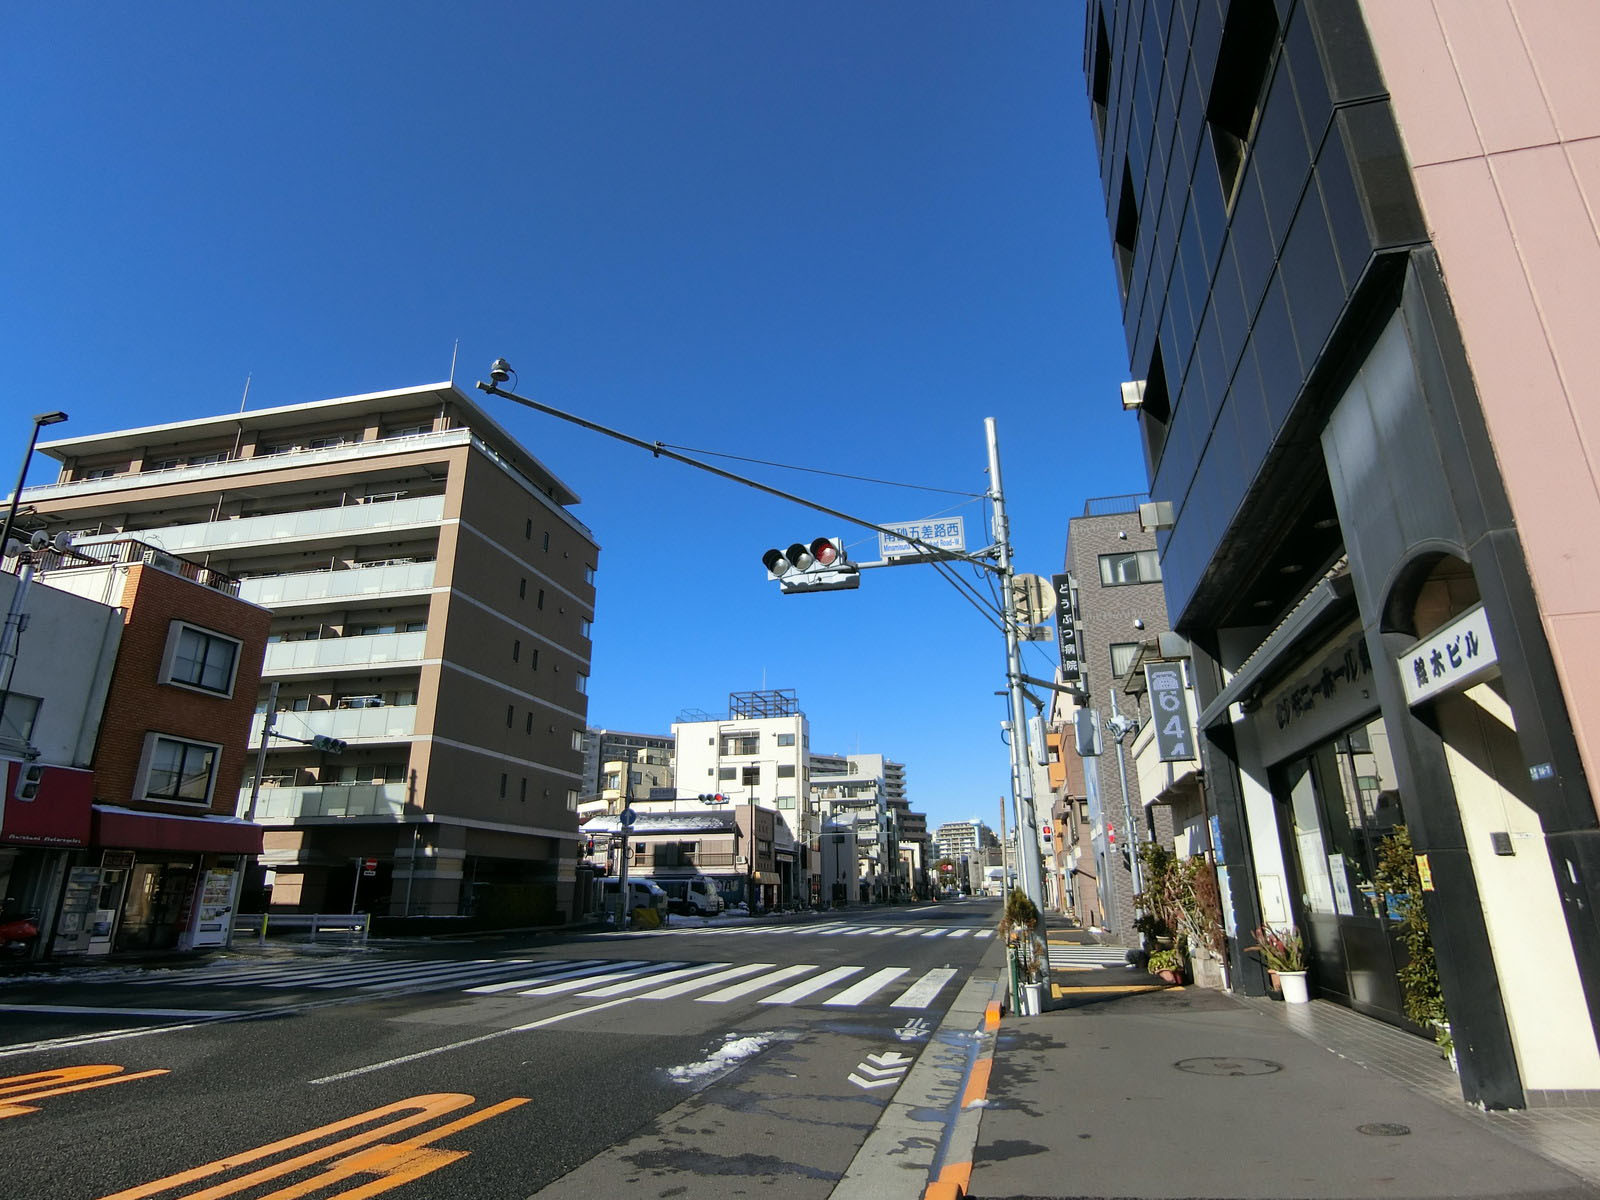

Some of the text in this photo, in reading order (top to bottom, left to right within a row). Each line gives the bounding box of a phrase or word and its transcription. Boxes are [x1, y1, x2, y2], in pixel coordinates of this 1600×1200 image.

[1059, 583, 1078, 671] どうぶつ病院
